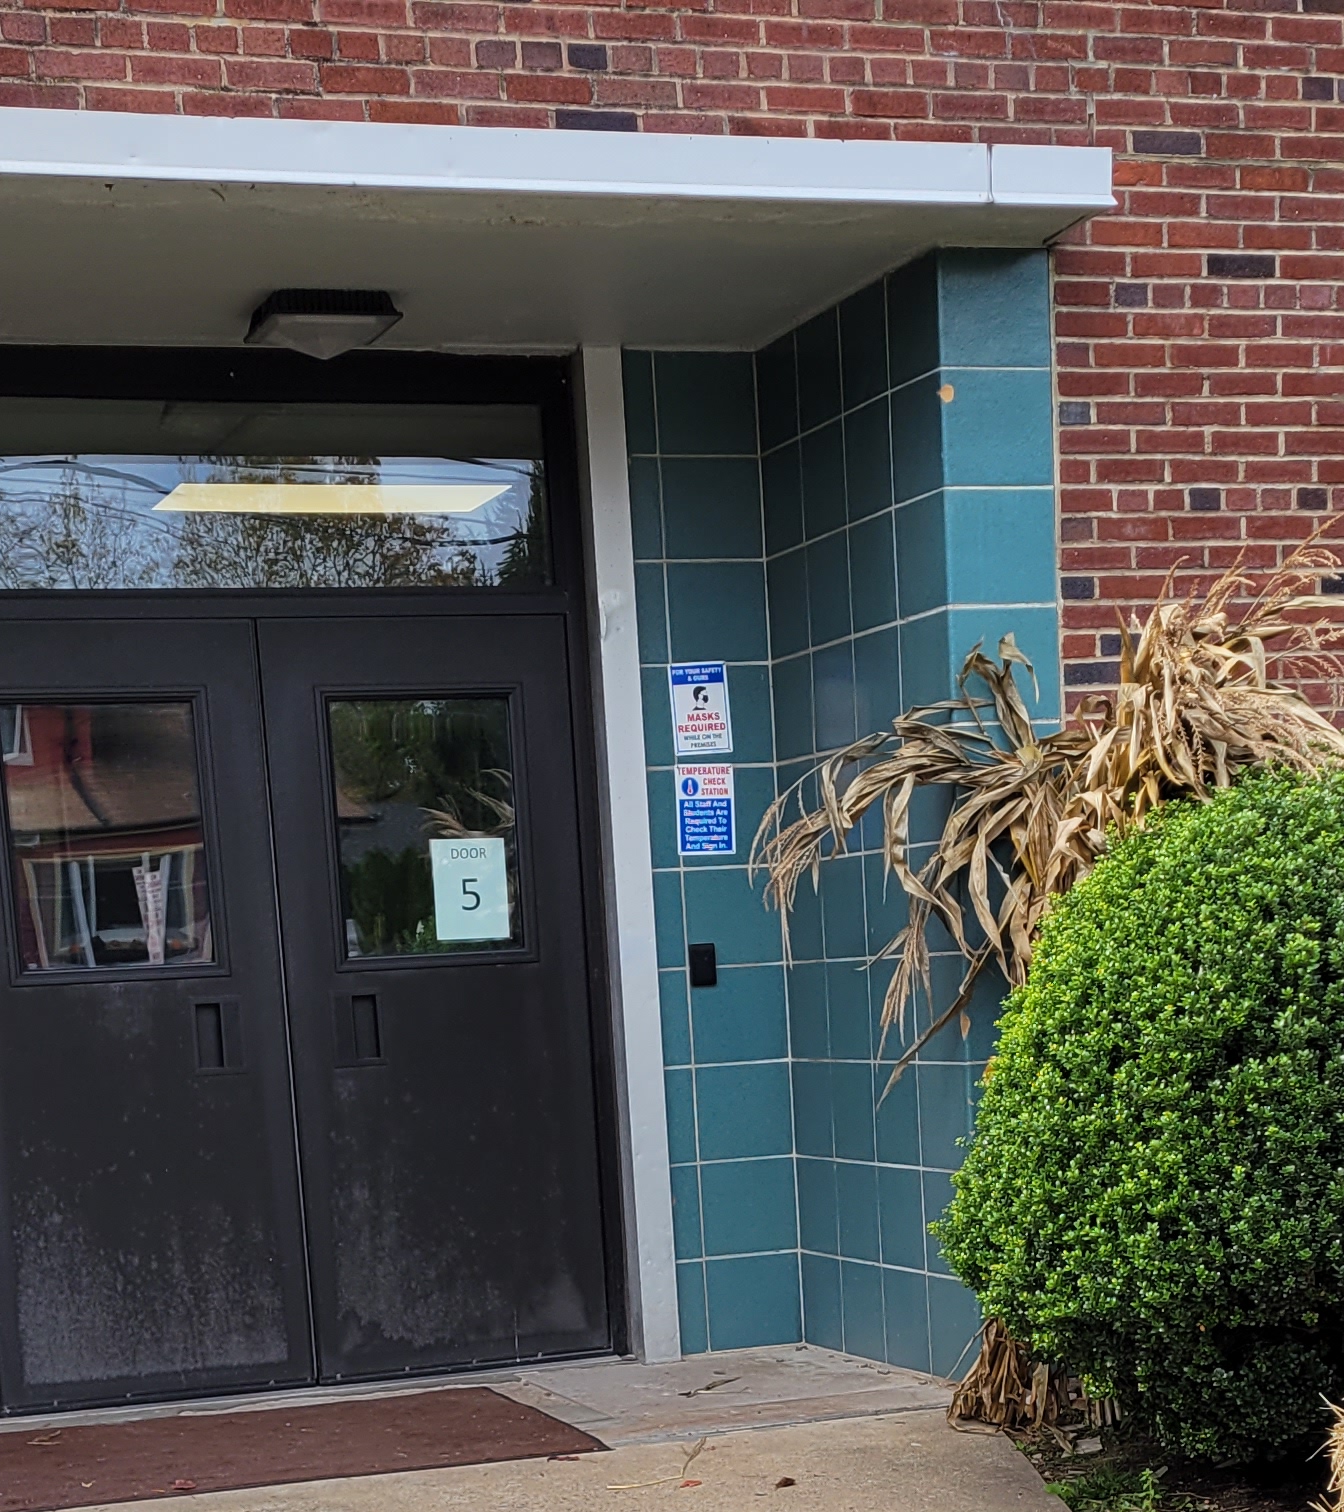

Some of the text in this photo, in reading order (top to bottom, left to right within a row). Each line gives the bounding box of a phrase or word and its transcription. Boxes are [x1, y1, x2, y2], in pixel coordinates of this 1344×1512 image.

[687, 712, 720, 721] MASKS
[678, 723, 726, 732] REQUIRED
[678, 766, 730, 776] TEMPERATURE
[685, 818, 716, 826] Required
[451, 848, 486, 859] DOOR
[461, 878, 481, 910] 5
